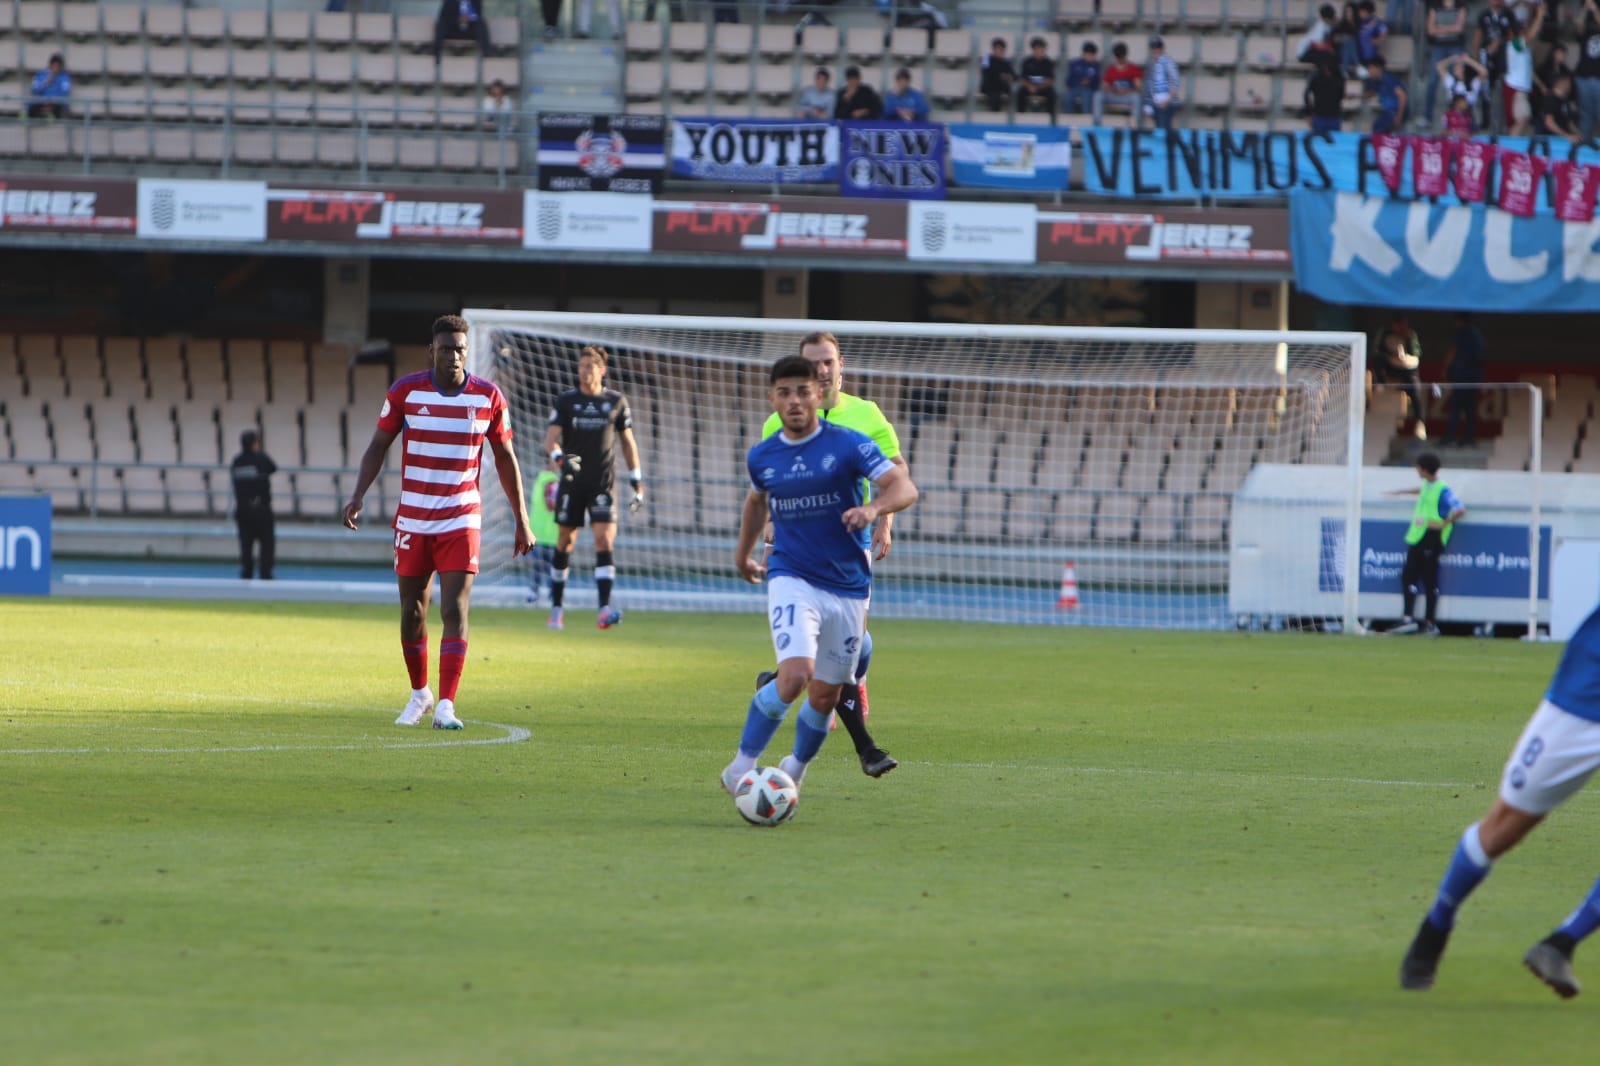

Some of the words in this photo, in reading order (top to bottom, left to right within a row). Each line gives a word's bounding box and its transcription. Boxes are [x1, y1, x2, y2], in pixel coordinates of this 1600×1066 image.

[684, 126, 828, 166] YOUTH
[847, 128, 940, 157] NEW
[846, 157, 941, 192] ONES
[1086, 127, 1336, 194] VENIMOS
[281, 199, 374, 224] PLAY
[356, 197, 485, 238] JEREZ
[666, 210, 759, 234] PLAY
[740, 207, 869, 248] JEREZ
[1051, 221, 1143, 245] PLAY
[1124, 217, 1253, 260] JEREZ
[778, 491, 841, 511] HIPOTELS
[1474, 552, 1495, 569] de
[1497, 553, 1531, 572] Jere
[772, 603, 796, 630] 21
[1522, 736, 1544, 767] 8
